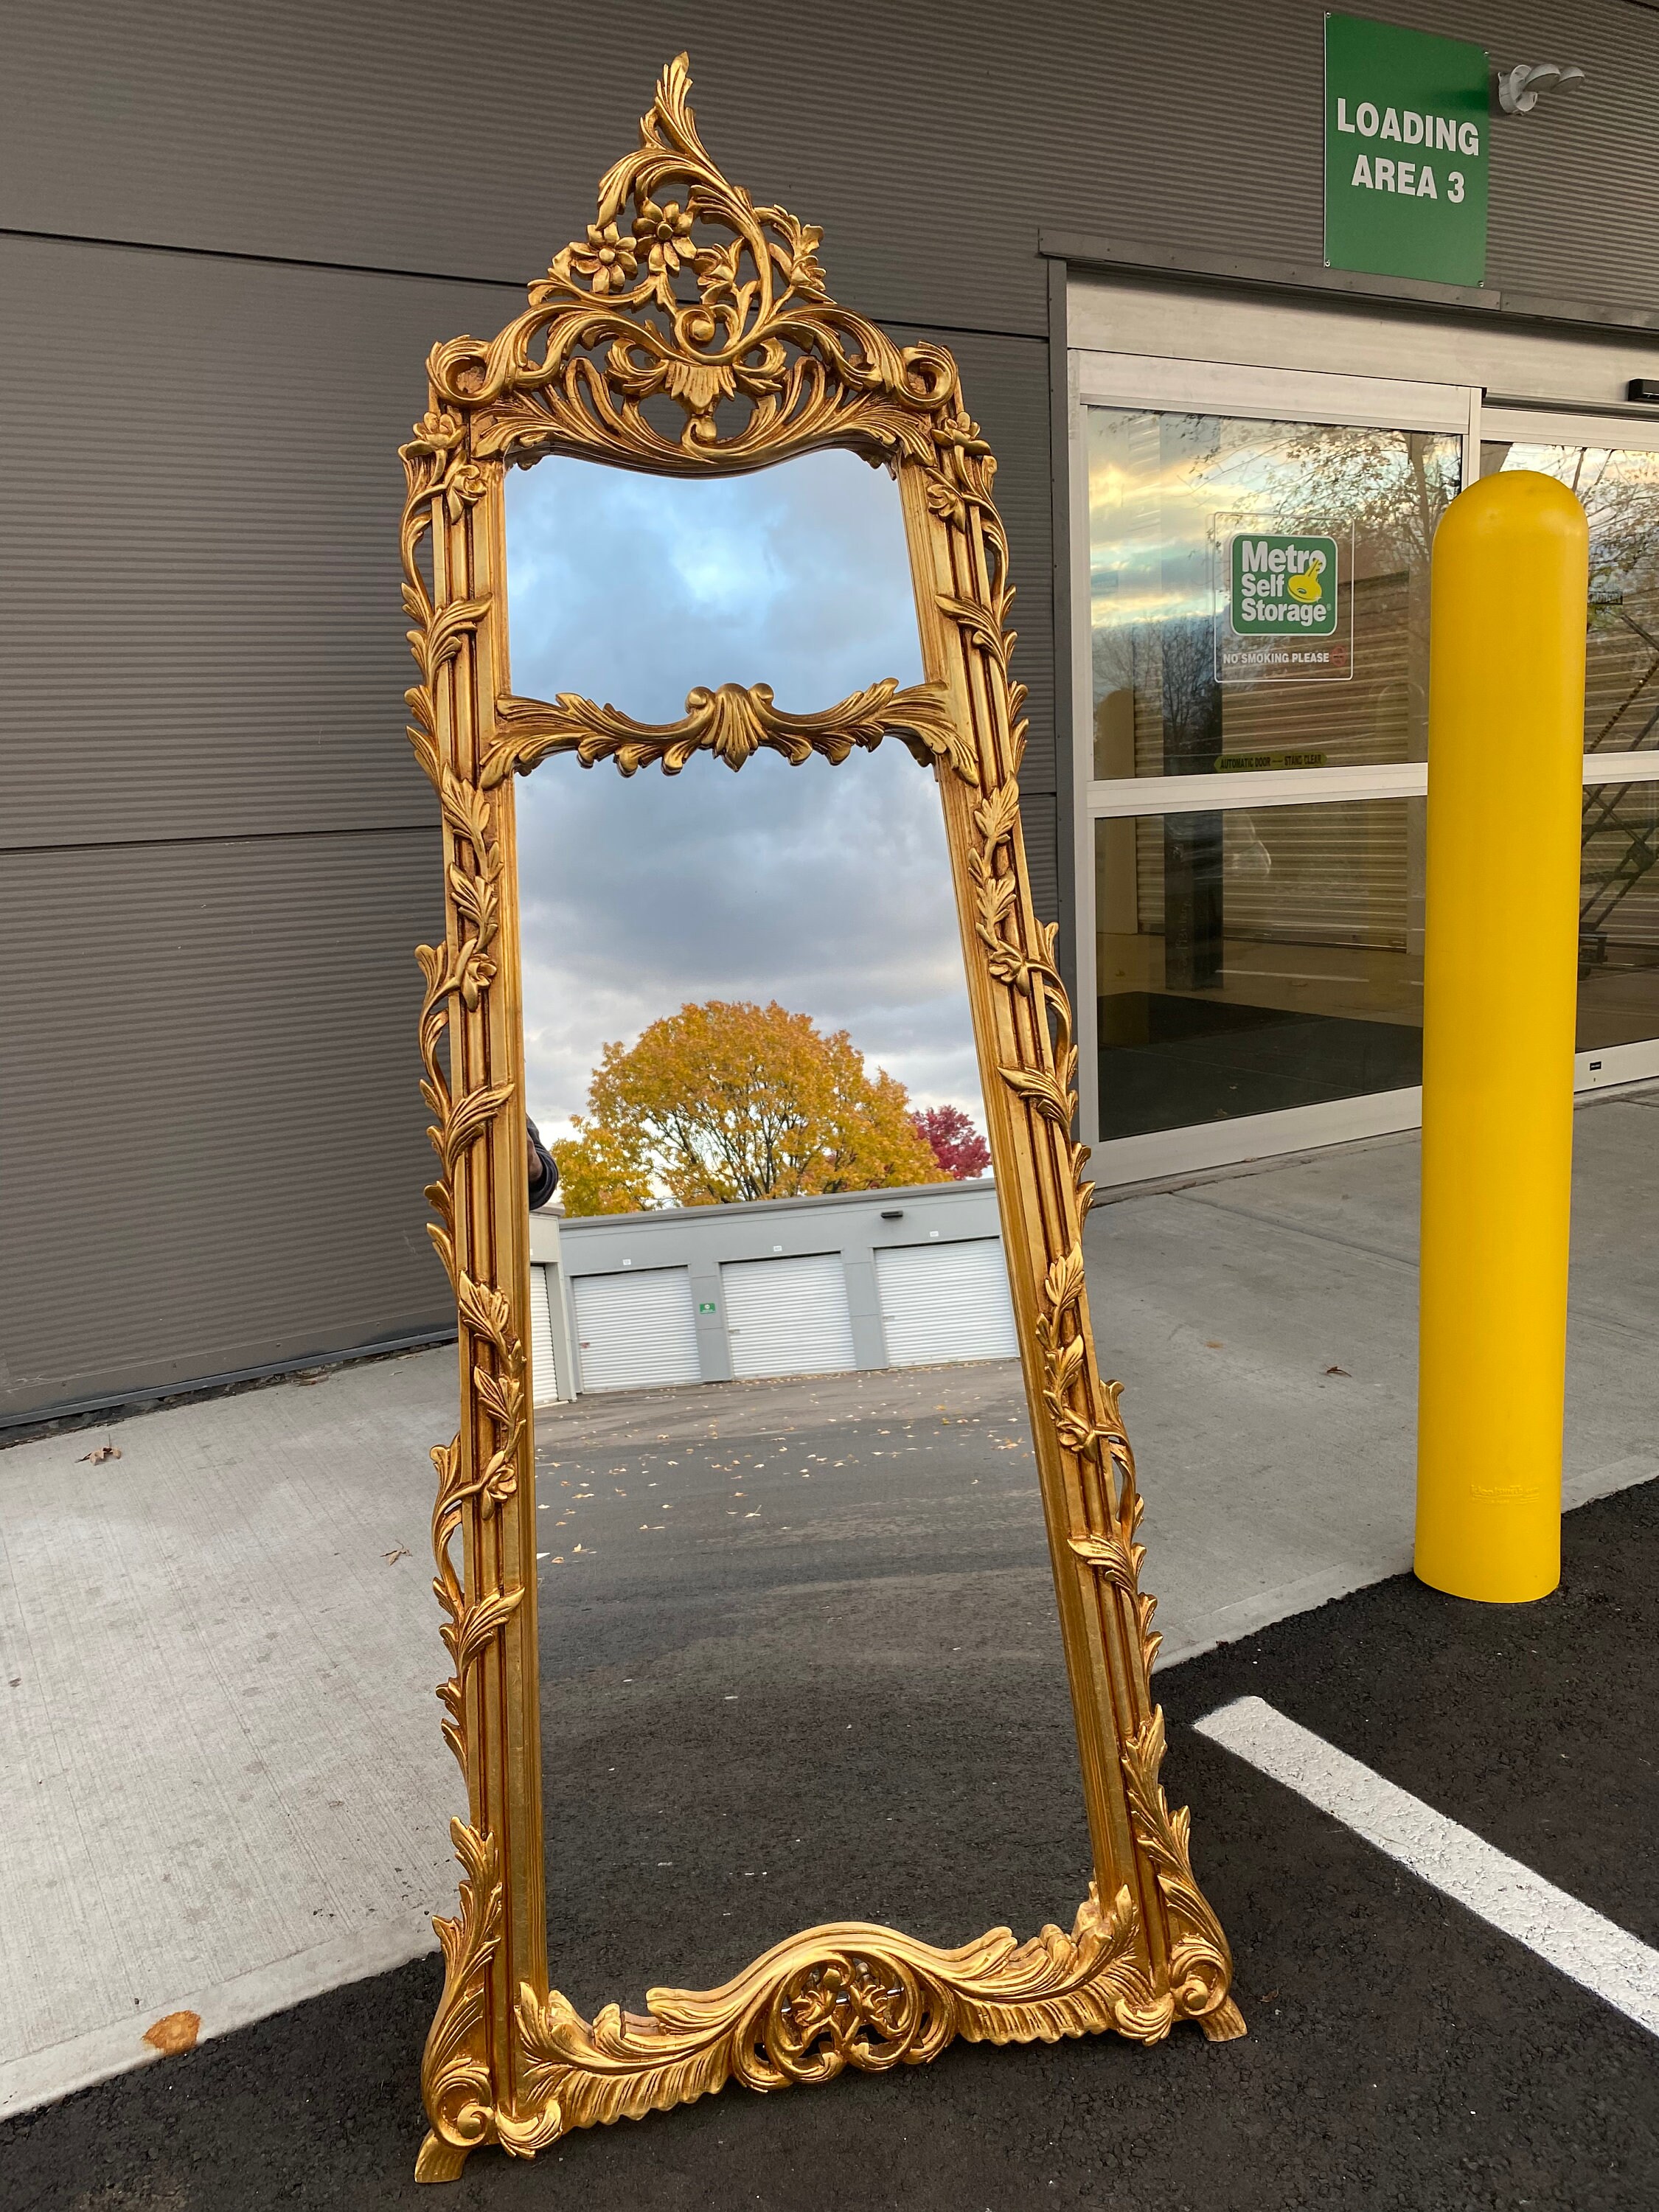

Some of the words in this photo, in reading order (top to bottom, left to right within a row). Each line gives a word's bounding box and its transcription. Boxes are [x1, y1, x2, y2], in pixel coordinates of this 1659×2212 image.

[1337, 98, 1479, 156] LOADING
[1352, 154, 1438, 199] AREA
[1447, 172, 1465, 203] 3
[1242, 540, 1326, 574] Metro
[1242, 573, 1284, 597] Self
[1242, 597, 1326, 626] Storage
[1223, 653, 1239, 664] NO
[1242, 653, 1289, 664] SMOKING
[1292, 653, 1329, 663] PLEASE
[1220, 757, 1253, 768] AUTOMATIC
[1255, 757, 1271, 767] DOOR
[1284, 755, 1302, 765] STAND
[1304, 754, 1322, 765] CLEAR
